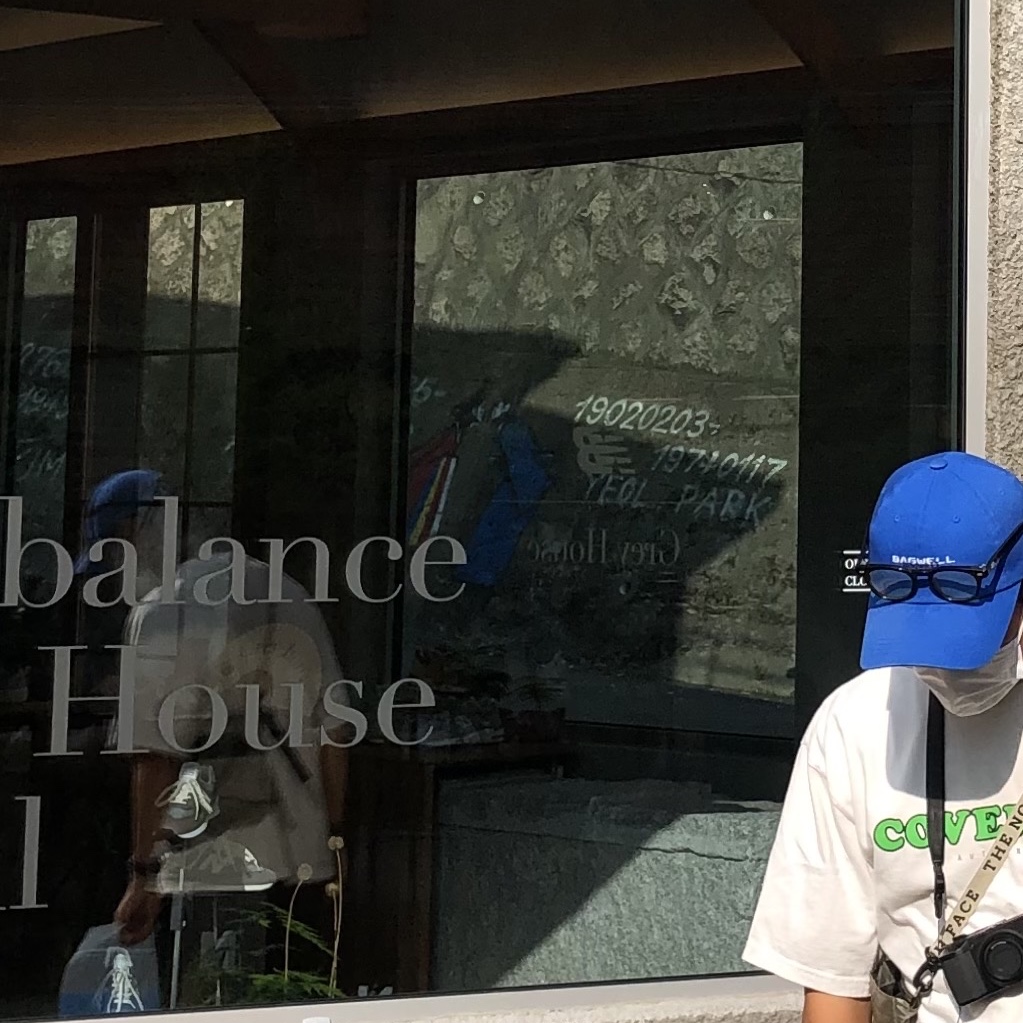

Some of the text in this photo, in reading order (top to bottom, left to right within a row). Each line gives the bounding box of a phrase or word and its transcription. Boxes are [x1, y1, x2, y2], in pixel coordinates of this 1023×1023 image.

[0, 496, 468, 608] balance
[675, 485, 771, 526] PARK
[33, 645, 436, 757] House
[946, 889, 979, 937] FACE
[983, 833, 1013, 872] THE
